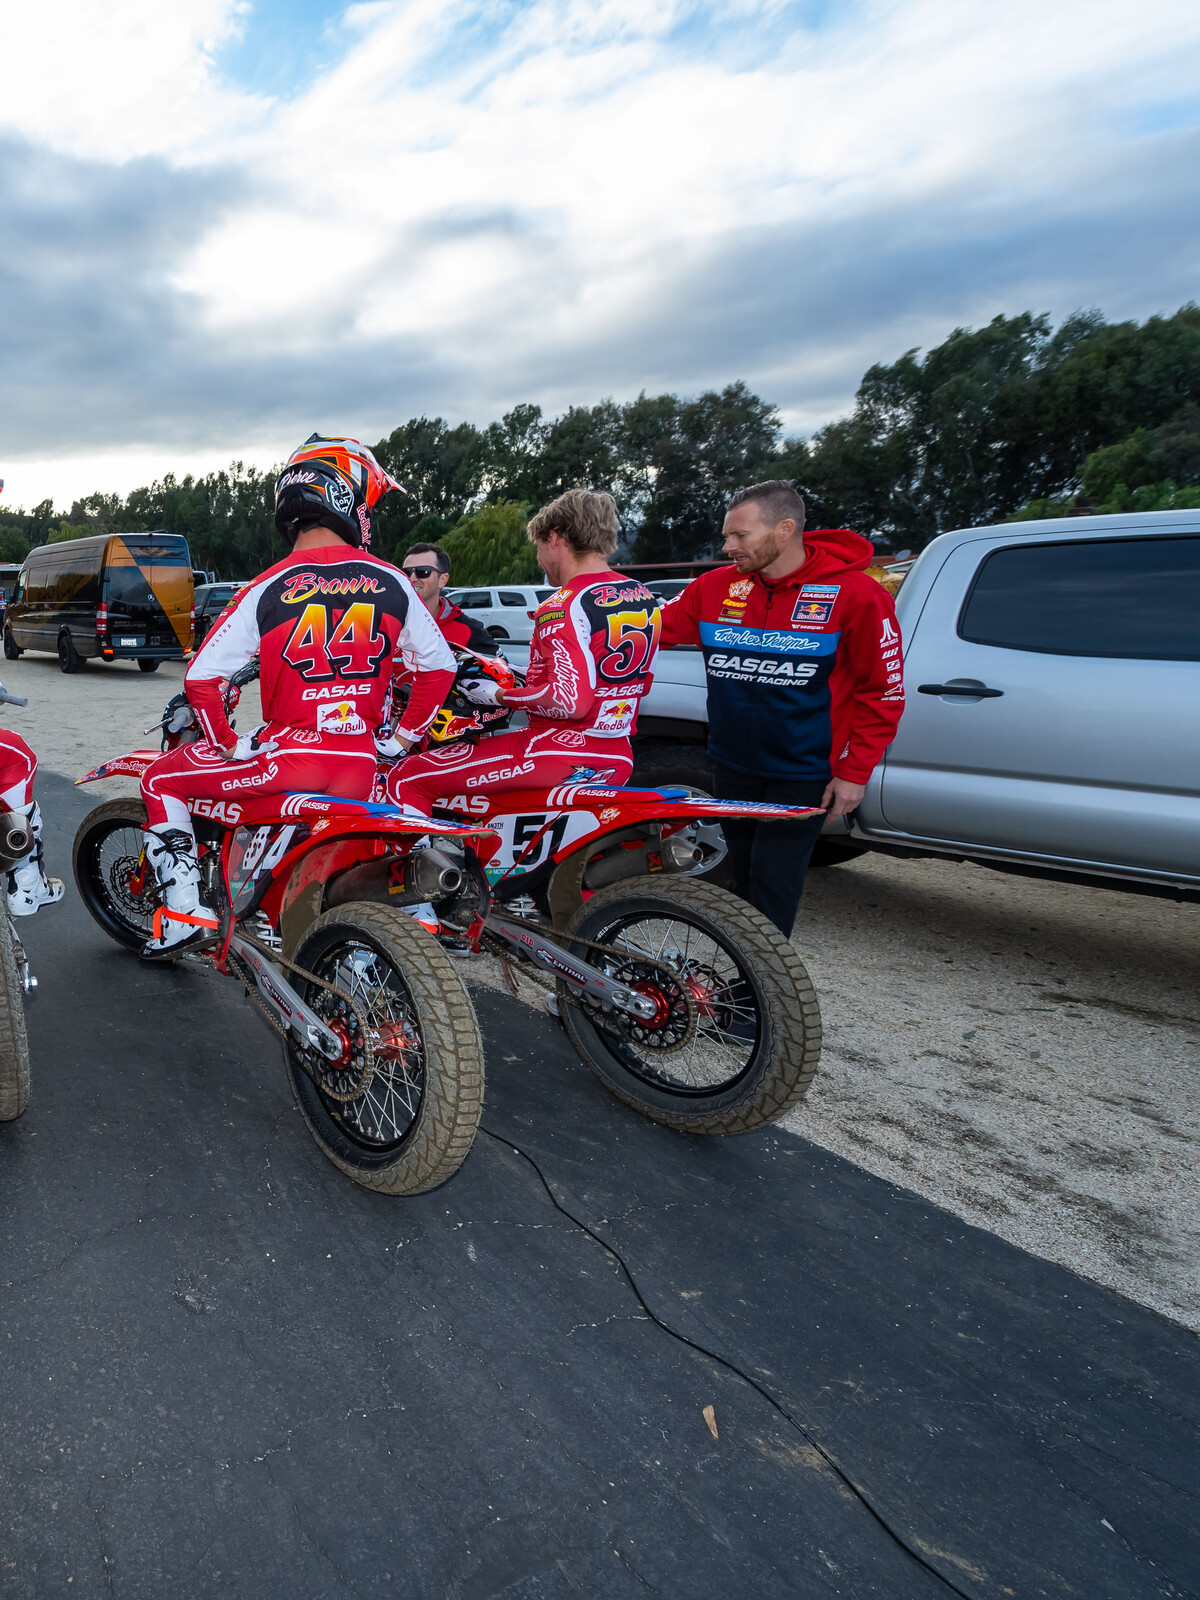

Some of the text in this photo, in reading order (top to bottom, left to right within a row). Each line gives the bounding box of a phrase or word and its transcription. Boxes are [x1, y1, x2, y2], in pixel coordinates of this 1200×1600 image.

[280, 573, 387, 604] Brown
[210, 623, 233, 648] ULTRA
[282, 601, 390, 682] 44
[598, 606, 663, 681] 51
[714, 627, 820, 651] Troy Lee Designs
[707, 668, 809, 686] FACTORY RACING
[708, 653, 819, 678] GASGAS
[301, 684, 372, 701] GASAS
[344, 719, 364, 734] Bull
[596, 720, 616, 731] Red
[221, 761, 279, 792] GASGAS
[466, 759, 536, 788] GASGAS
[301, 800, 331, 811] GASGAS
[577, 789, 618, 798] GASGAS
[716, 805, 788, 814] DUNLOP
[512, 814, 570, 866] 51
